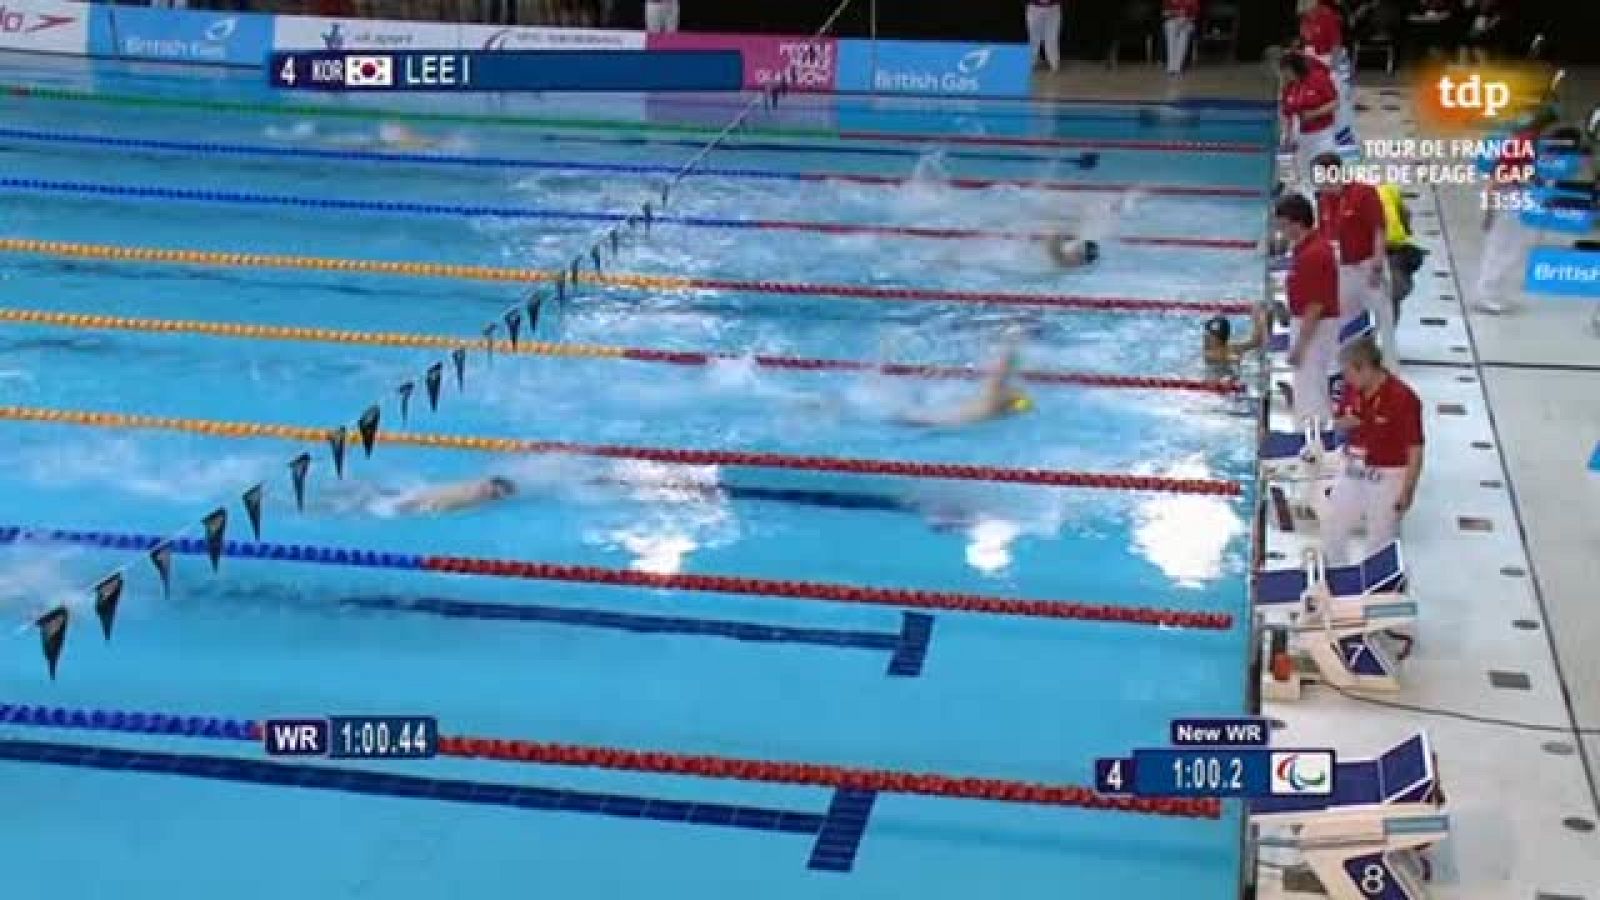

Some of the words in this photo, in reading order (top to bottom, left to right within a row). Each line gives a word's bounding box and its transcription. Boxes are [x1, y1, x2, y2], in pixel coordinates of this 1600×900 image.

[874, 69, 937, 91] British
[941, 72, 980, 92] Gas
[1347, 642, 1363, 666] 7
[1361, 864, 1384, 893] 8
